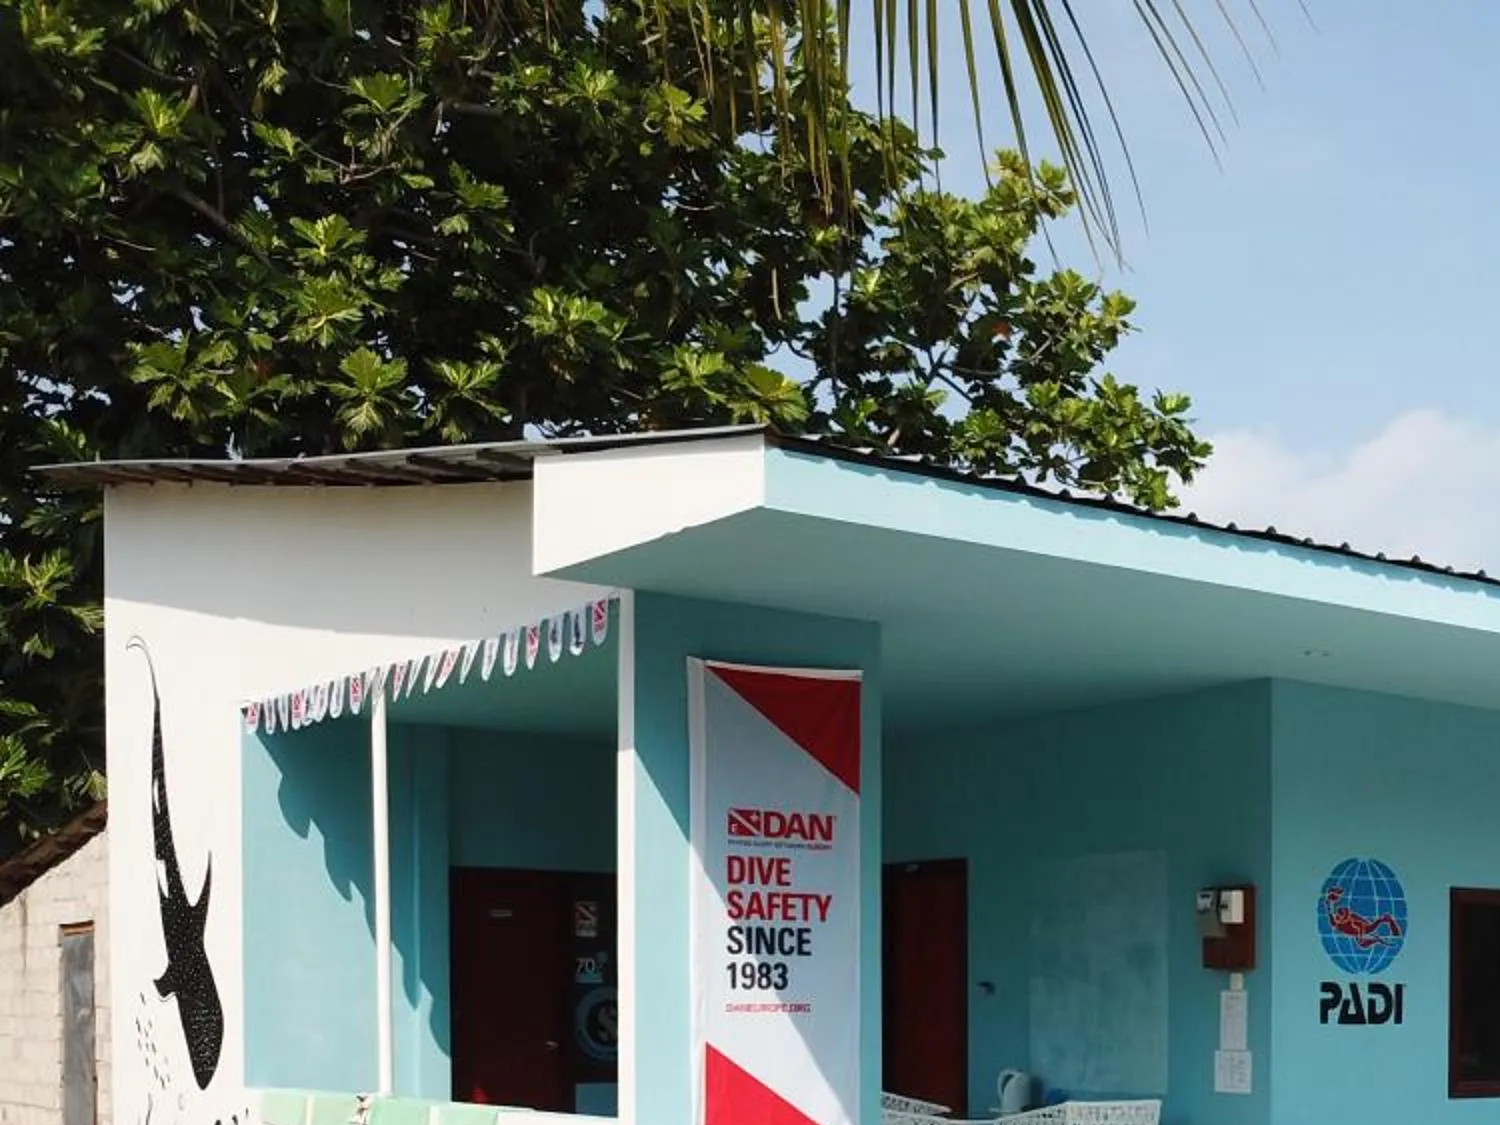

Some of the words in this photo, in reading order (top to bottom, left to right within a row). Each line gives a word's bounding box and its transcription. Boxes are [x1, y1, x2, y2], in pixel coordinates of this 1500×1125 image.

[763, 811, 833, 842] DAN
[727, 855, 791, 886] DIVE
[727, 891, 833, 922] SAFETY
[727, 926, 812, 956] SINCE
[726, 962, 788, 990] 1983
[1319, 981, 1403, 1025] PADI
